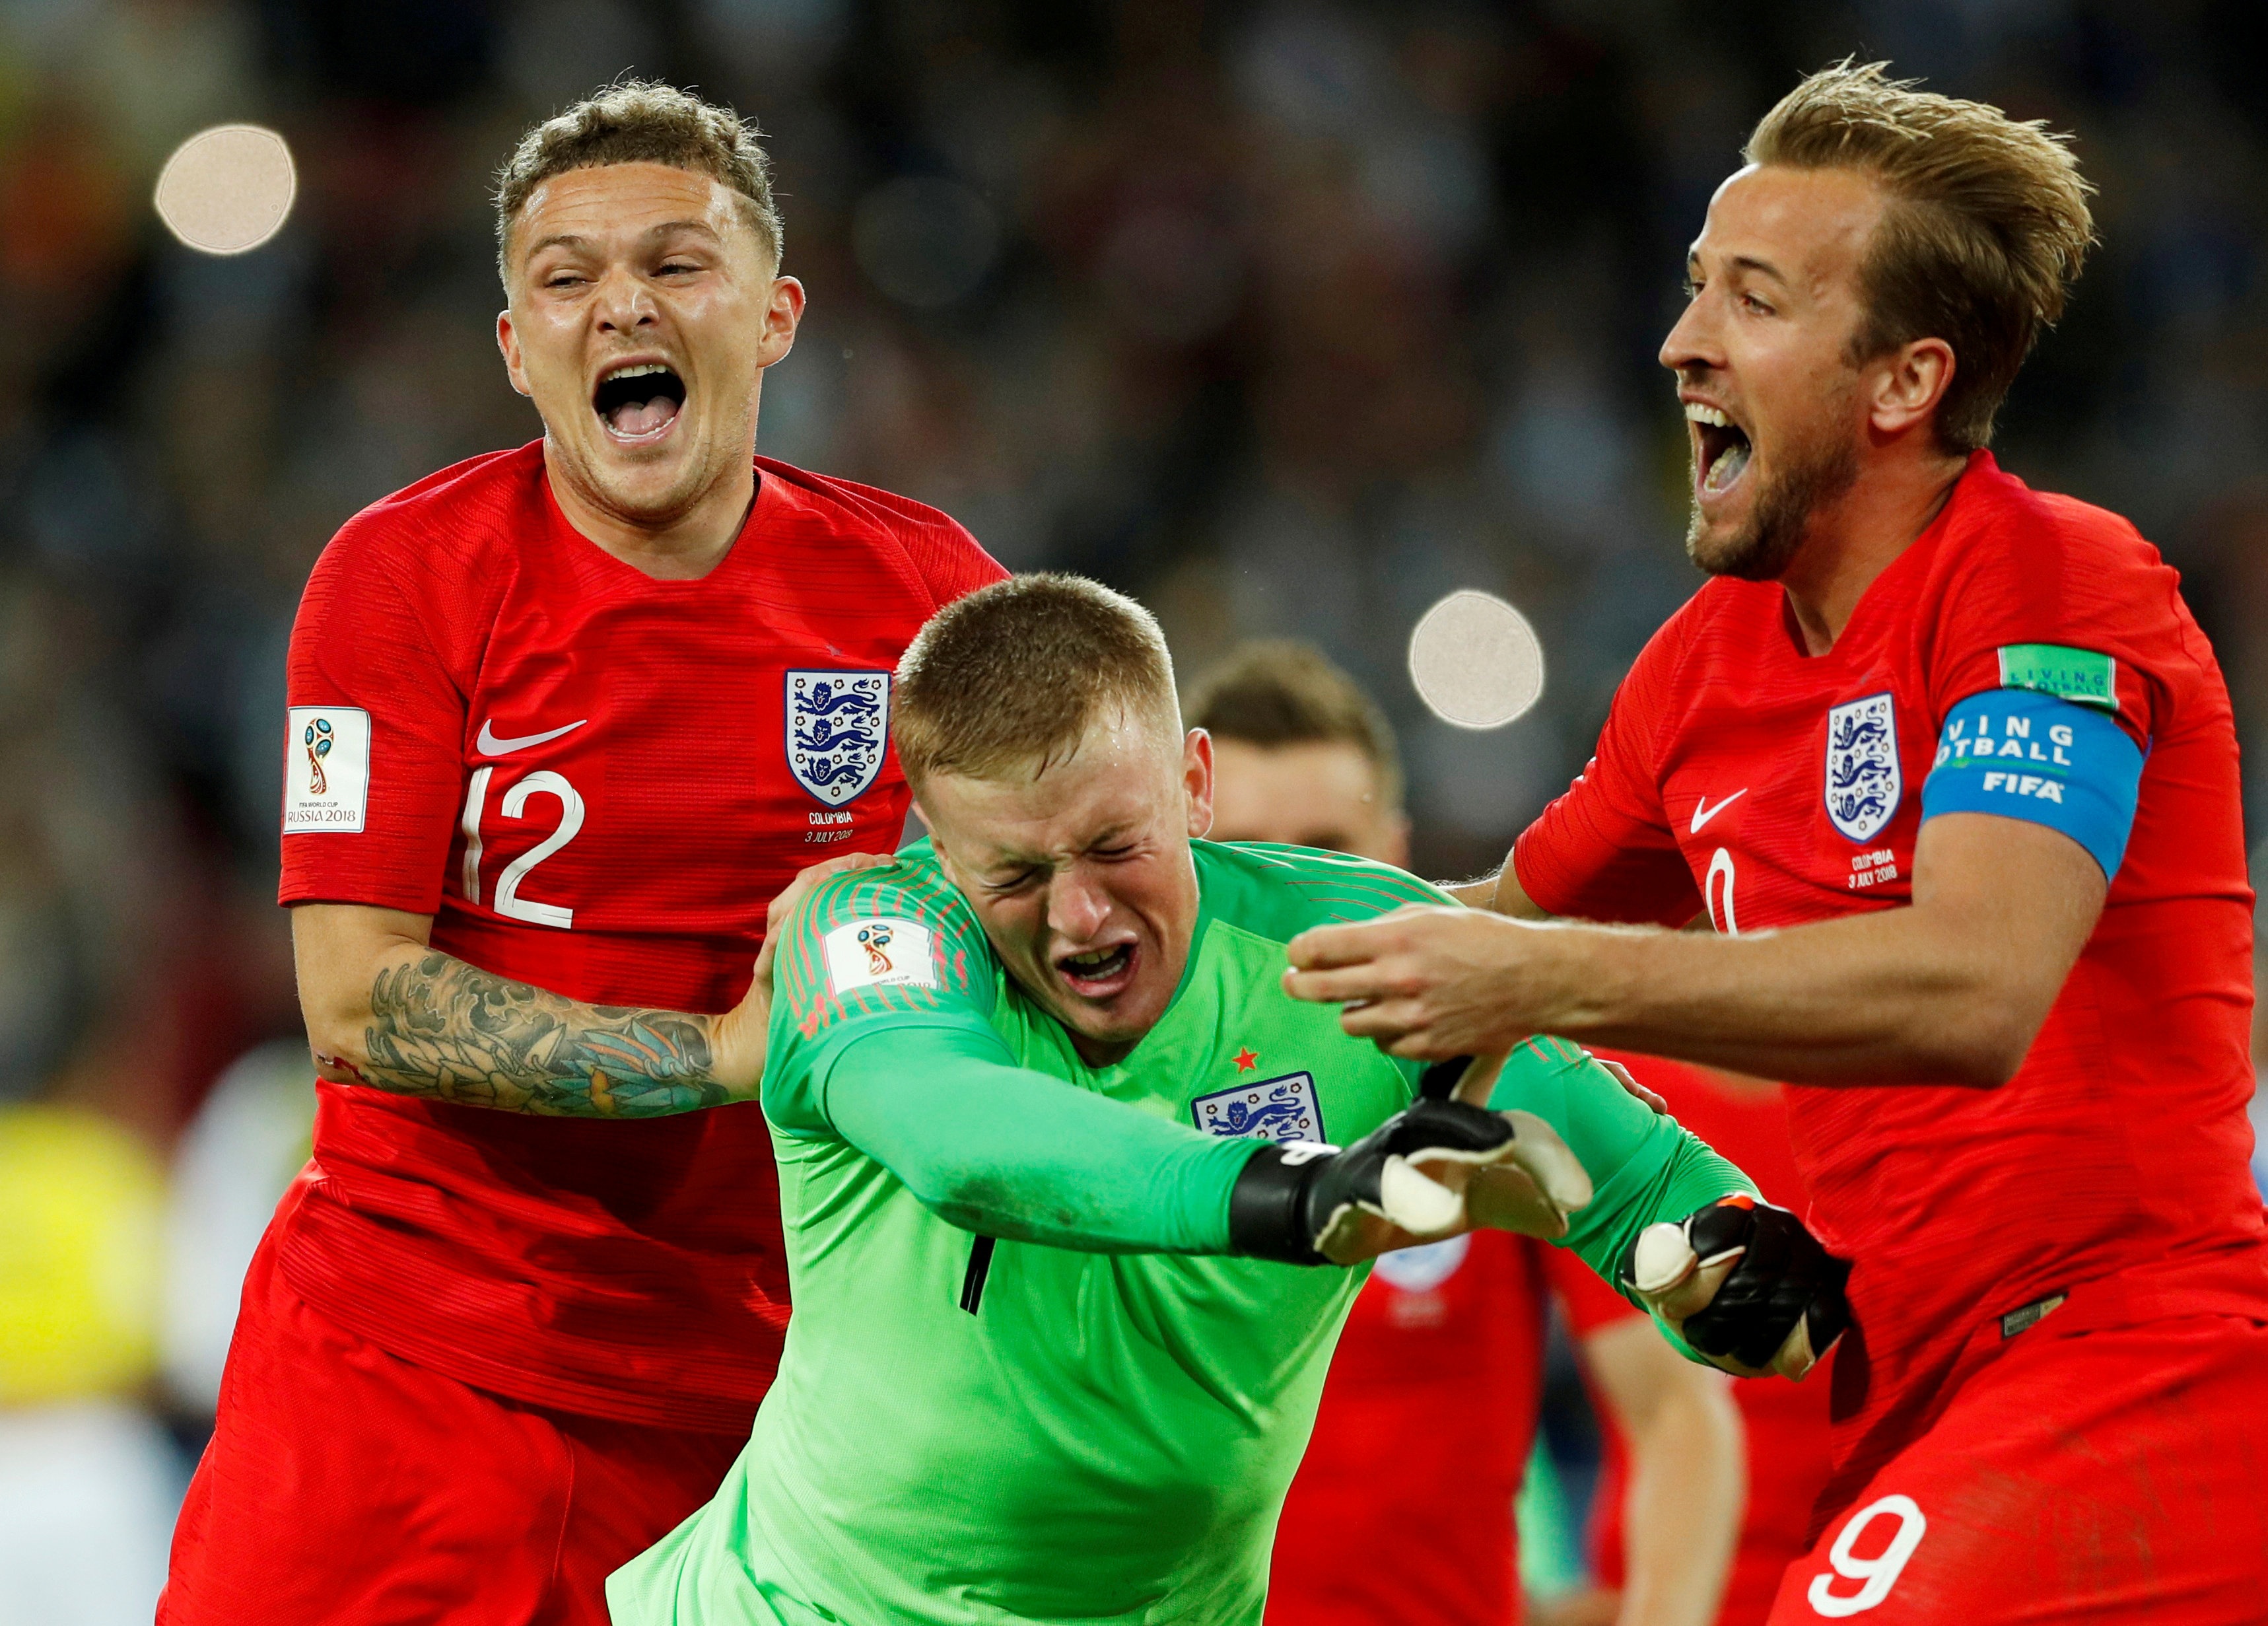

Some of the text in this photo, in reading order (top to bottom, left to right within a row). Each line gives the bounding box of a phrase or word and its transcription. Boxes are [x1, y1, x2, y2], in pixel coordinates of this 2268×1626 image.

[2010, 669, 2104, 686] LIVING
[1948, 715, 2073, 747] VING
[1935, 738, 2071, 766] OTBALL
[1983, 771, 2065, 804] FIFA
[288, 810, 356, 823] RUSSIA 2018
[809, 811, 853, 825] COLOMBIA
[462, 765, 585, 929] 12
[805, 831, 813, 842] 3
[813, 831, 835, 842] JULY
[1849, 864, 1897, 889] 3 JULY 2018
[1808, 1494, 1927, 1618] 9
